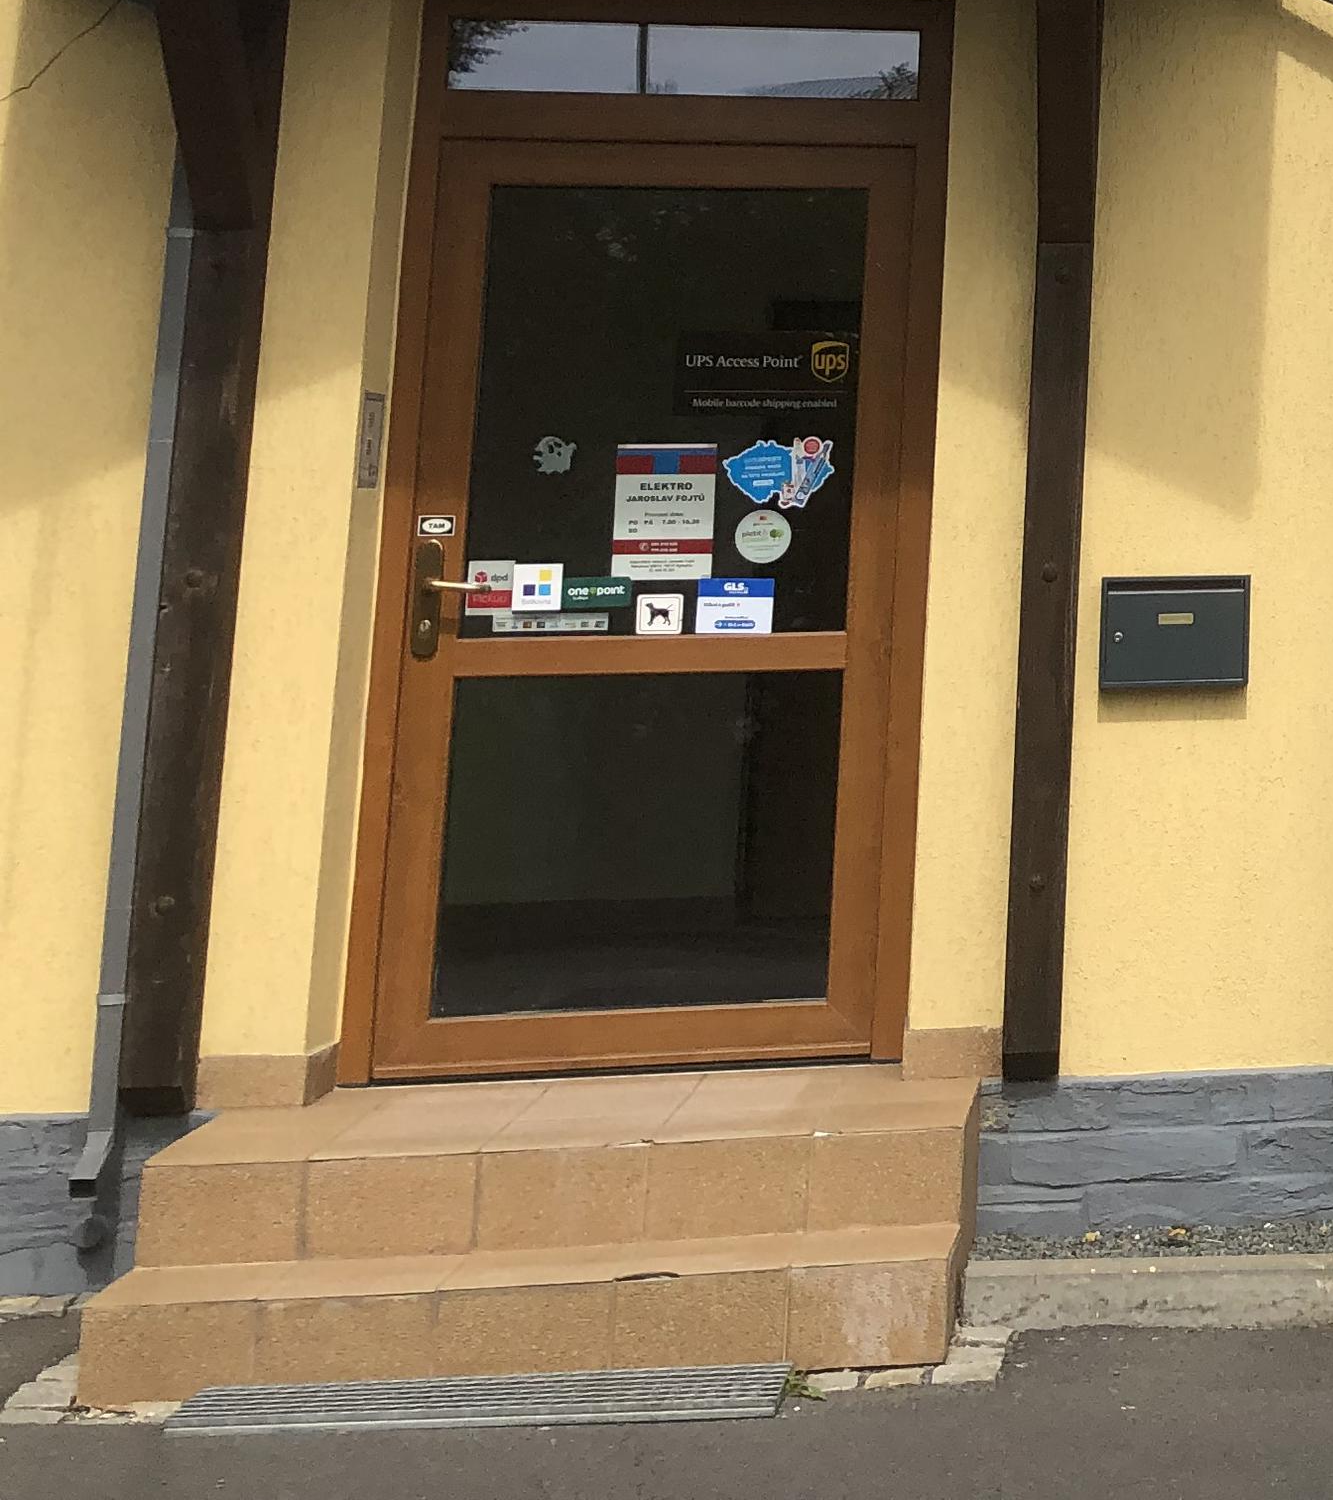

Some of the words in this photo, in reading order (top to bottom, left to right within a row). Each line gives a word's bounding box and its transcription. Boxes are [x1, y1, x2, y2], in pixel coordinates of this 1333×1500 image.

[686, 355, 713, 367] UPS
[716, 355, 760, 368] Access
[763, 355, 800, 368] Point
[814, 353, 846, 376] ups
[692, 399, 723, 408] Mobile
[726, 399, 760, 408] barcode
[640, 482, 693, 491] ELEKTRO
[567, 587, 589, 596] one
[596, 585, 626, 597] point
[723, 582, 745, 592] GLS
